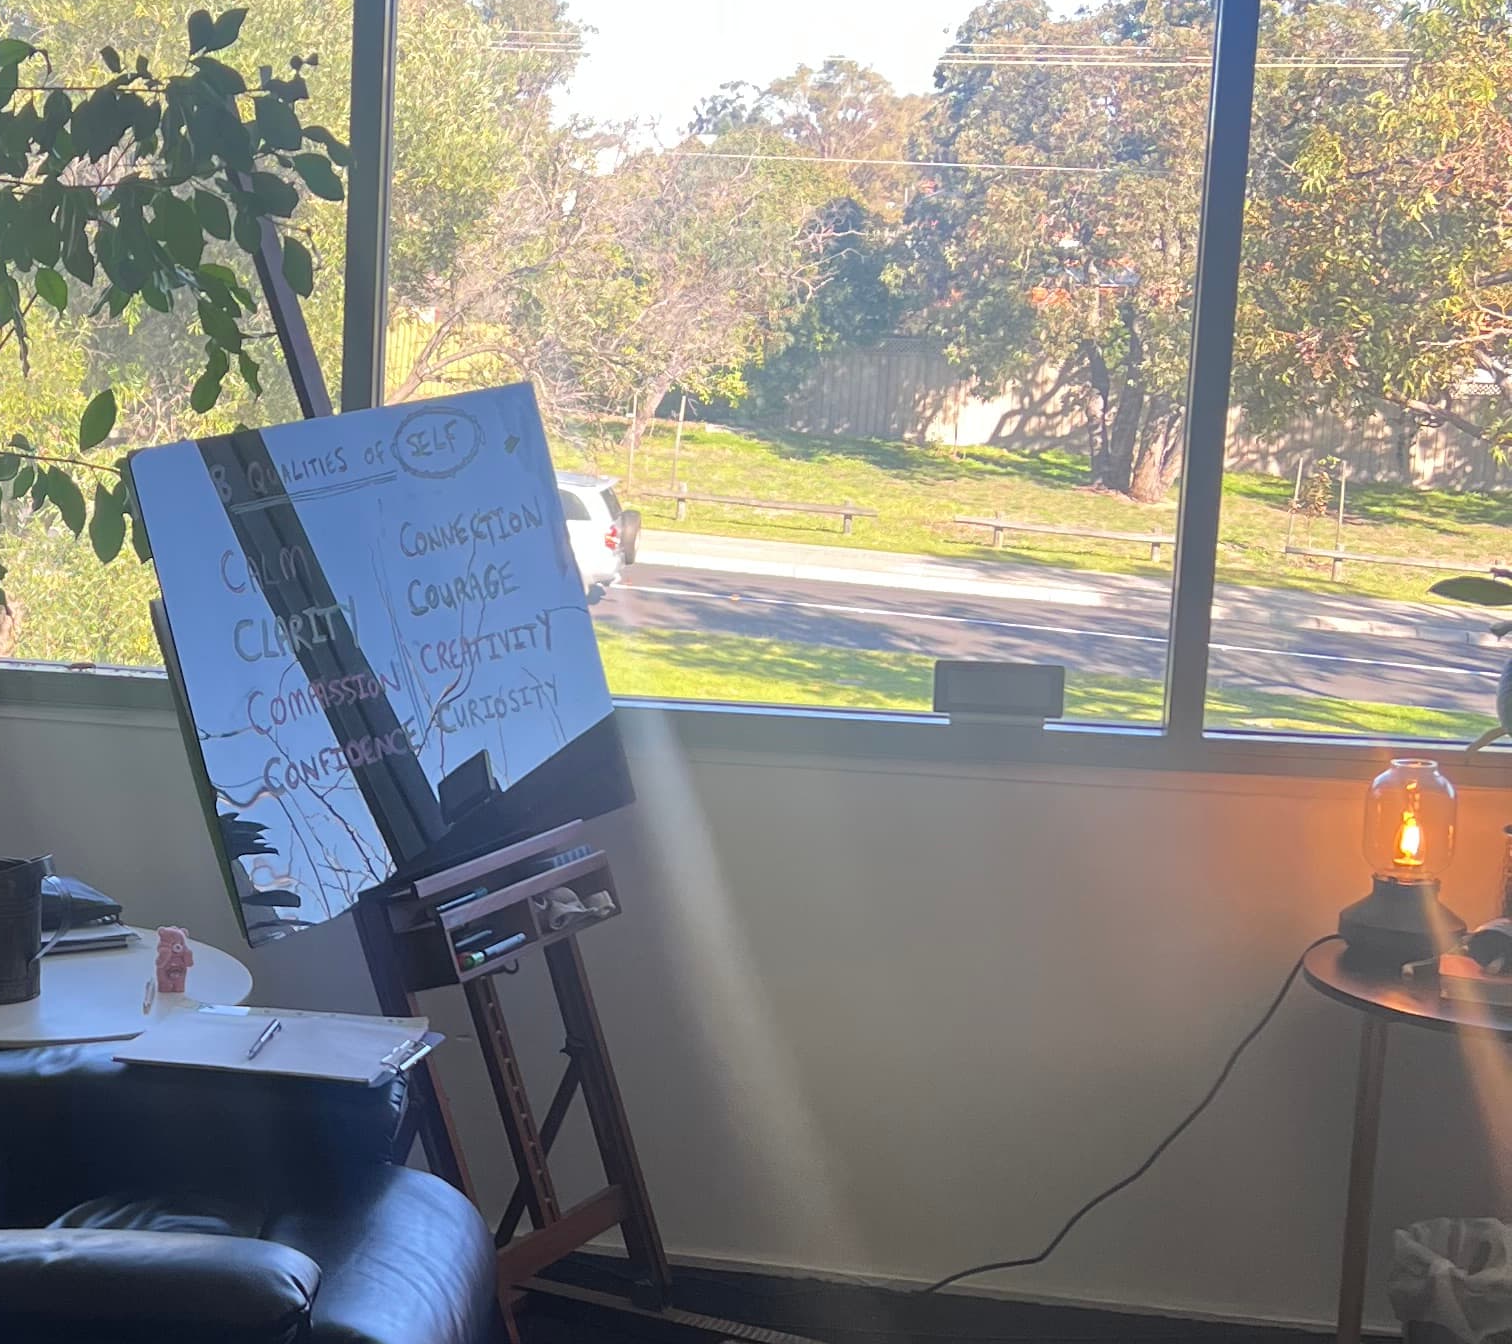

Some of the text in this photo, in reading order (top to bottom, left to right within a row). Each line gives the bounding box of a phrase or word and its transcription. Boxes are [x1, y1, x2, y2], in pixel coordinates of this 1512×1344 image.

[247, 446, 348, 496] QUALITIES
[363, 440, 385, 466] OF
[405, 419, 458, 457] SELF
[399, 496, 544, 558] CONNECTION
[219, 544, 313, 594] CALM
[407, 560, 521, 617] COURAGE
[233, 595, 361, 663] CLARITY
[419, 608, 553, 674] CREATIVITY
[247, 659, 403, 736] COMPASSION
[436, 674, 560, 734] CURIOSITY
[263, 714, 421, 796] CONFIDENCE
